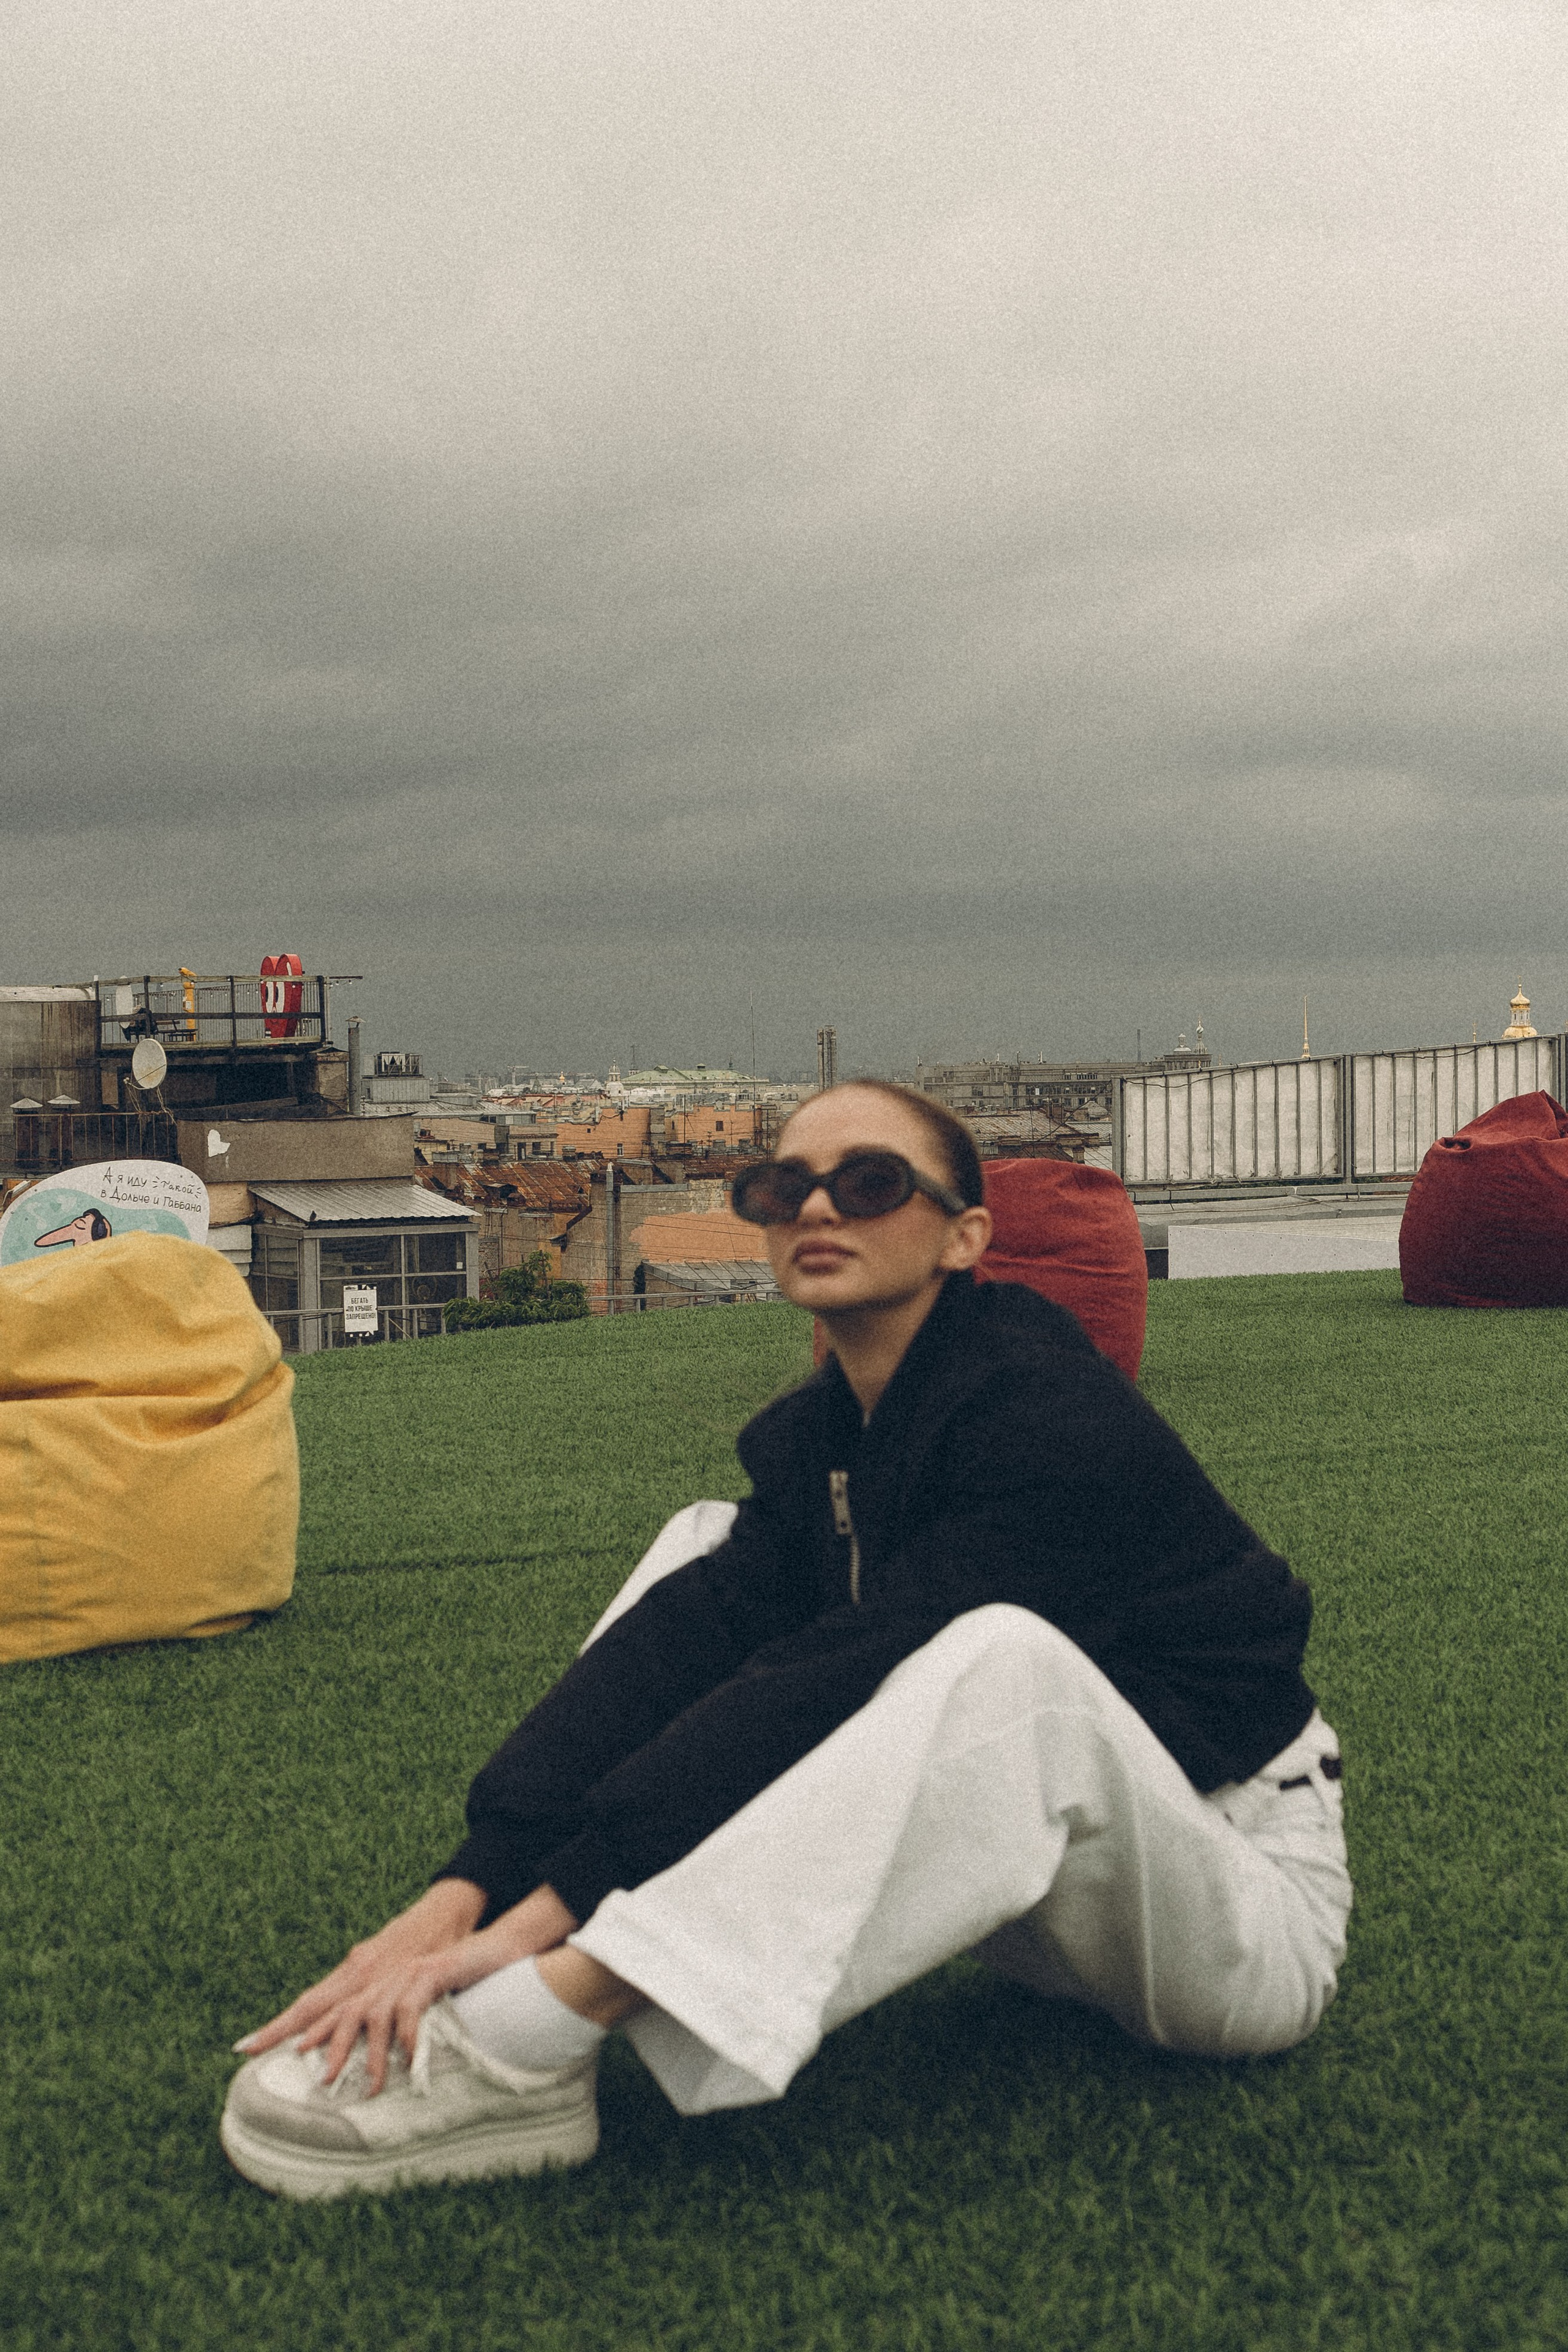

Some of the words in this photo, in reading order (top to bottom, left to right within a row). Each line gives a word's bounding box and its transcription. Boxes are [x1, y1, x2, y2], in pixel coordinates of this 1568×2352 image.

[103, 1166, 113, 1184] А
[117, 1175, 123, 1183] я
[127, 1176, 148, 1188] иду
[160, 1180, 195, 1194] такой
[109, 1186, 150, 1203] Дольче
